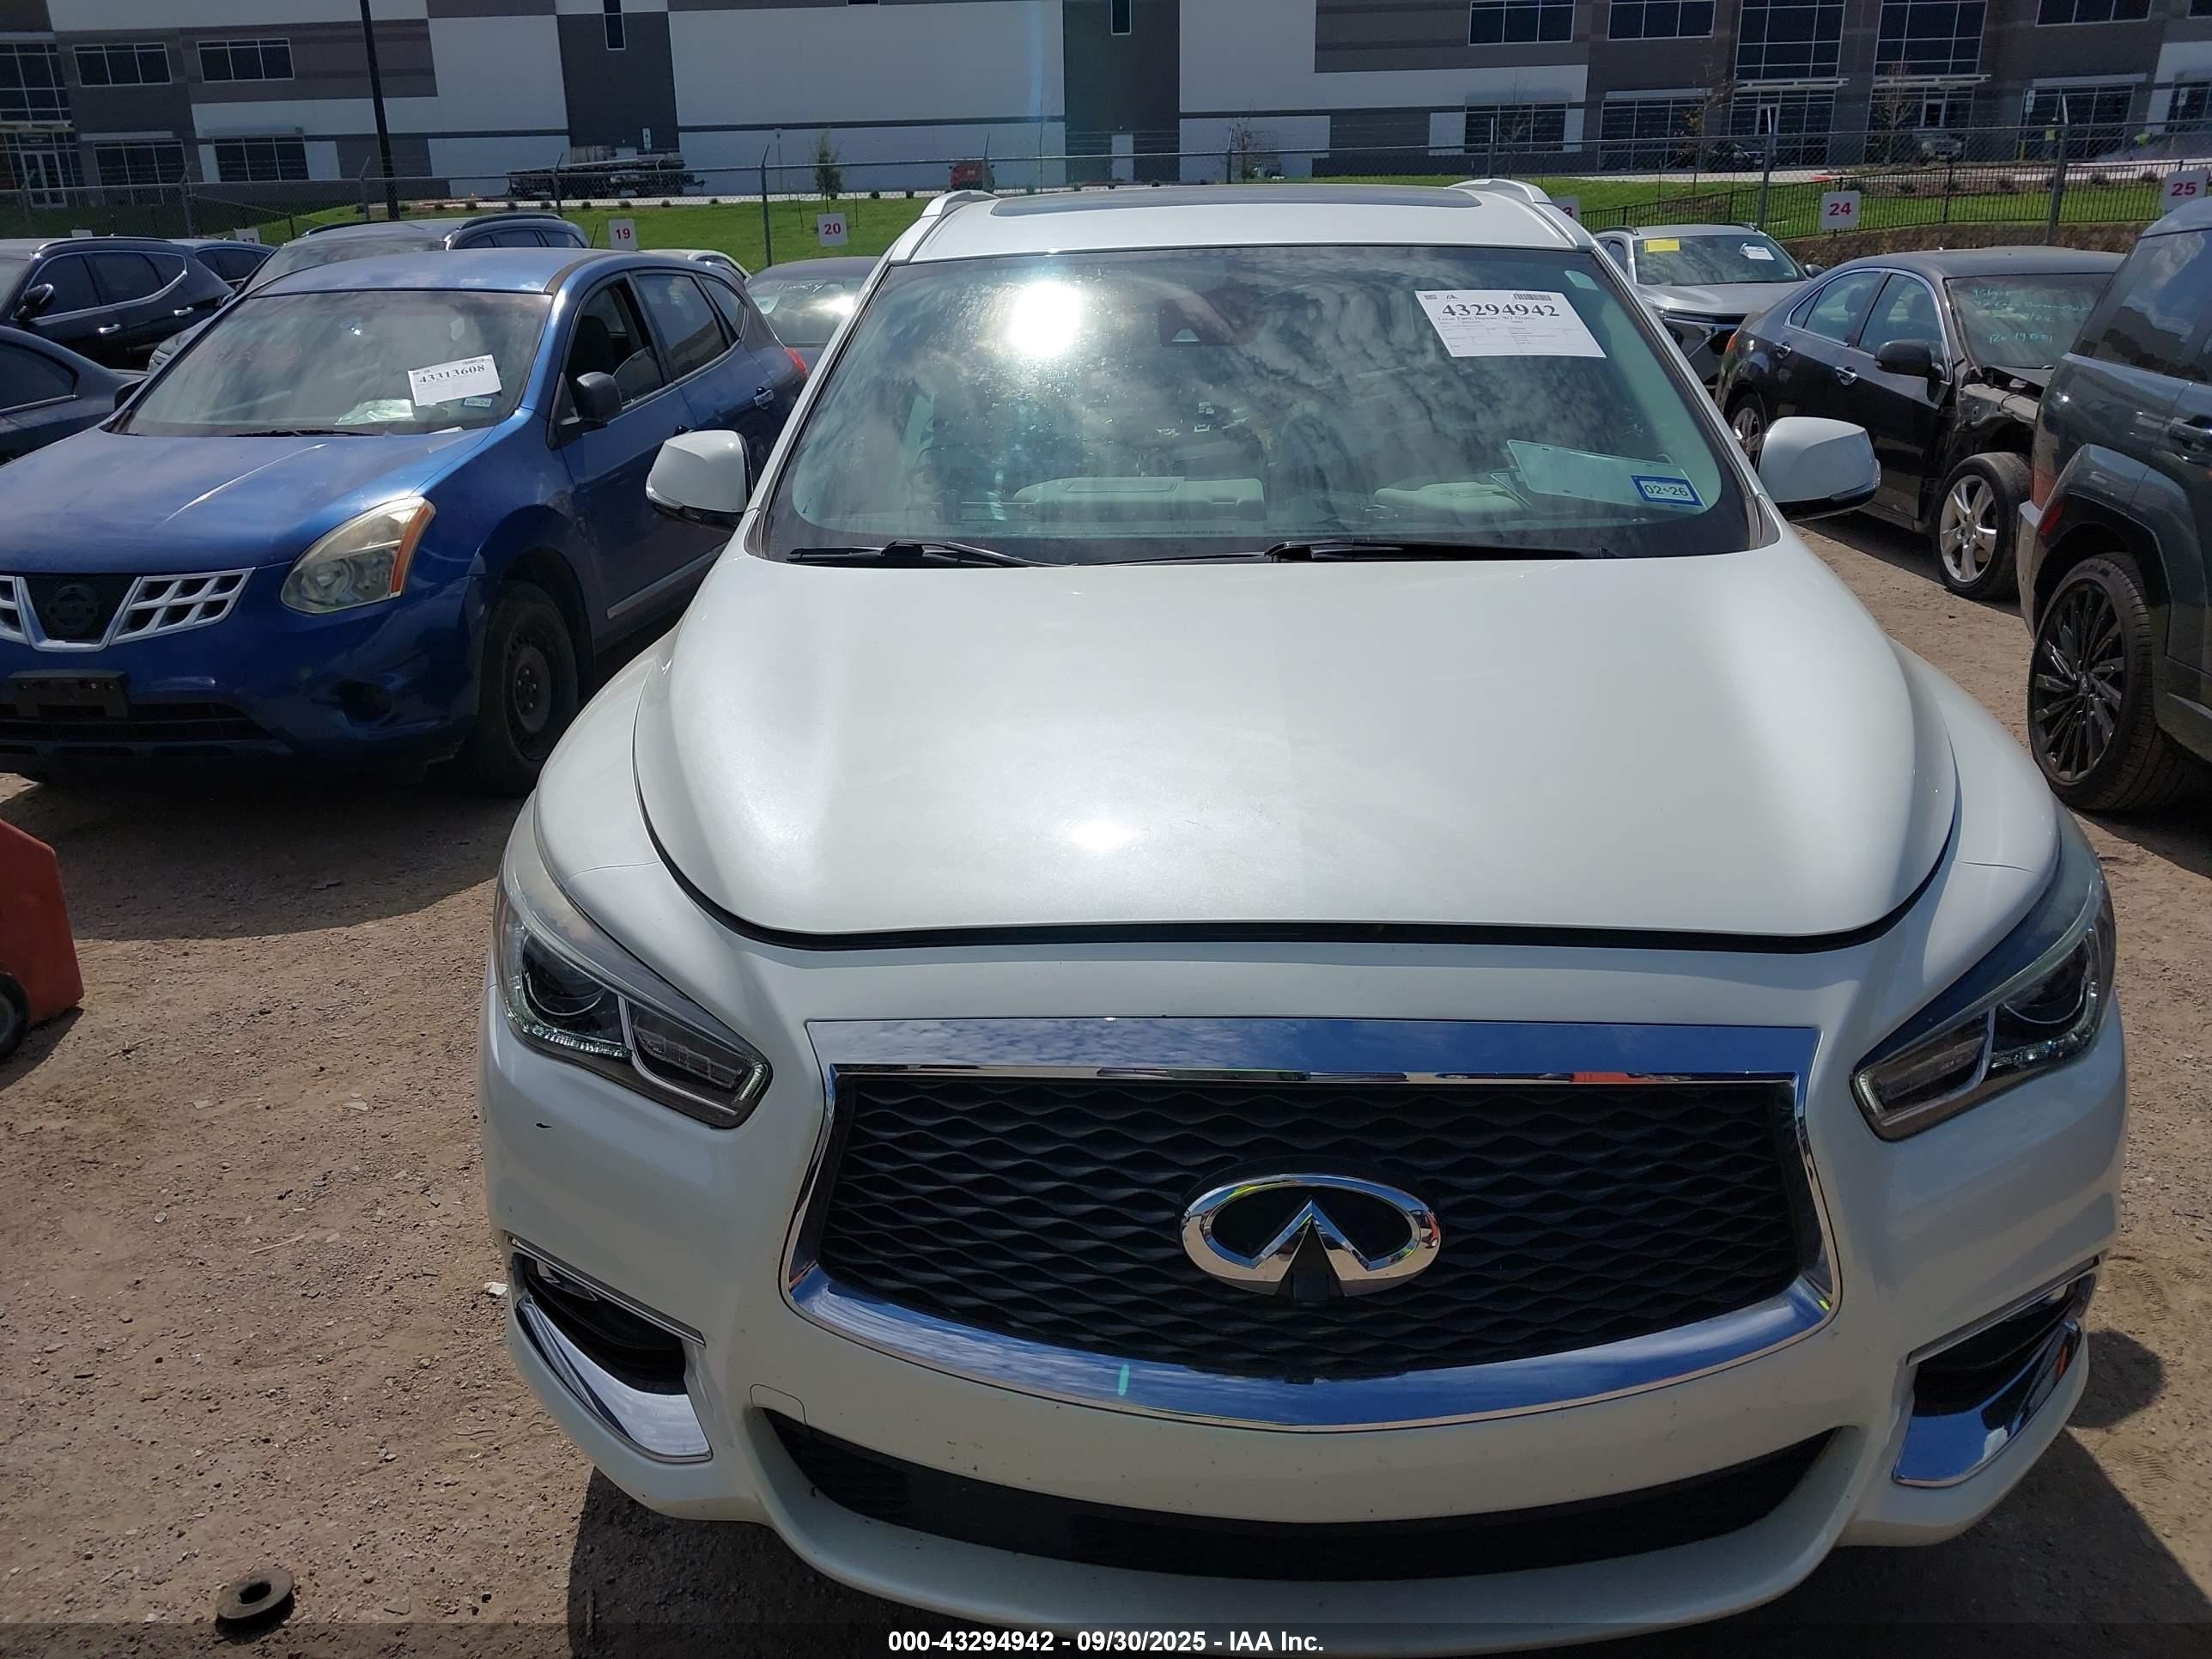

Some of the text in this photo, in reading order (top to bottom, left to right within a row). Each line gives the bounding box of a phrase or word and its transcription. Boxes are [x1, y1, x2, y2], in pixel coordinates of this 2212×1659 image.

[2171, 181, 2197, 196] 25
[1828, 203, 1852, 216] 24
[615, 228, 631, 240] 19
[823, 222, 842, 234] 20
[1442, 302, 1560, 317] 43294942
[418, 364, 486, 383] 43313608
